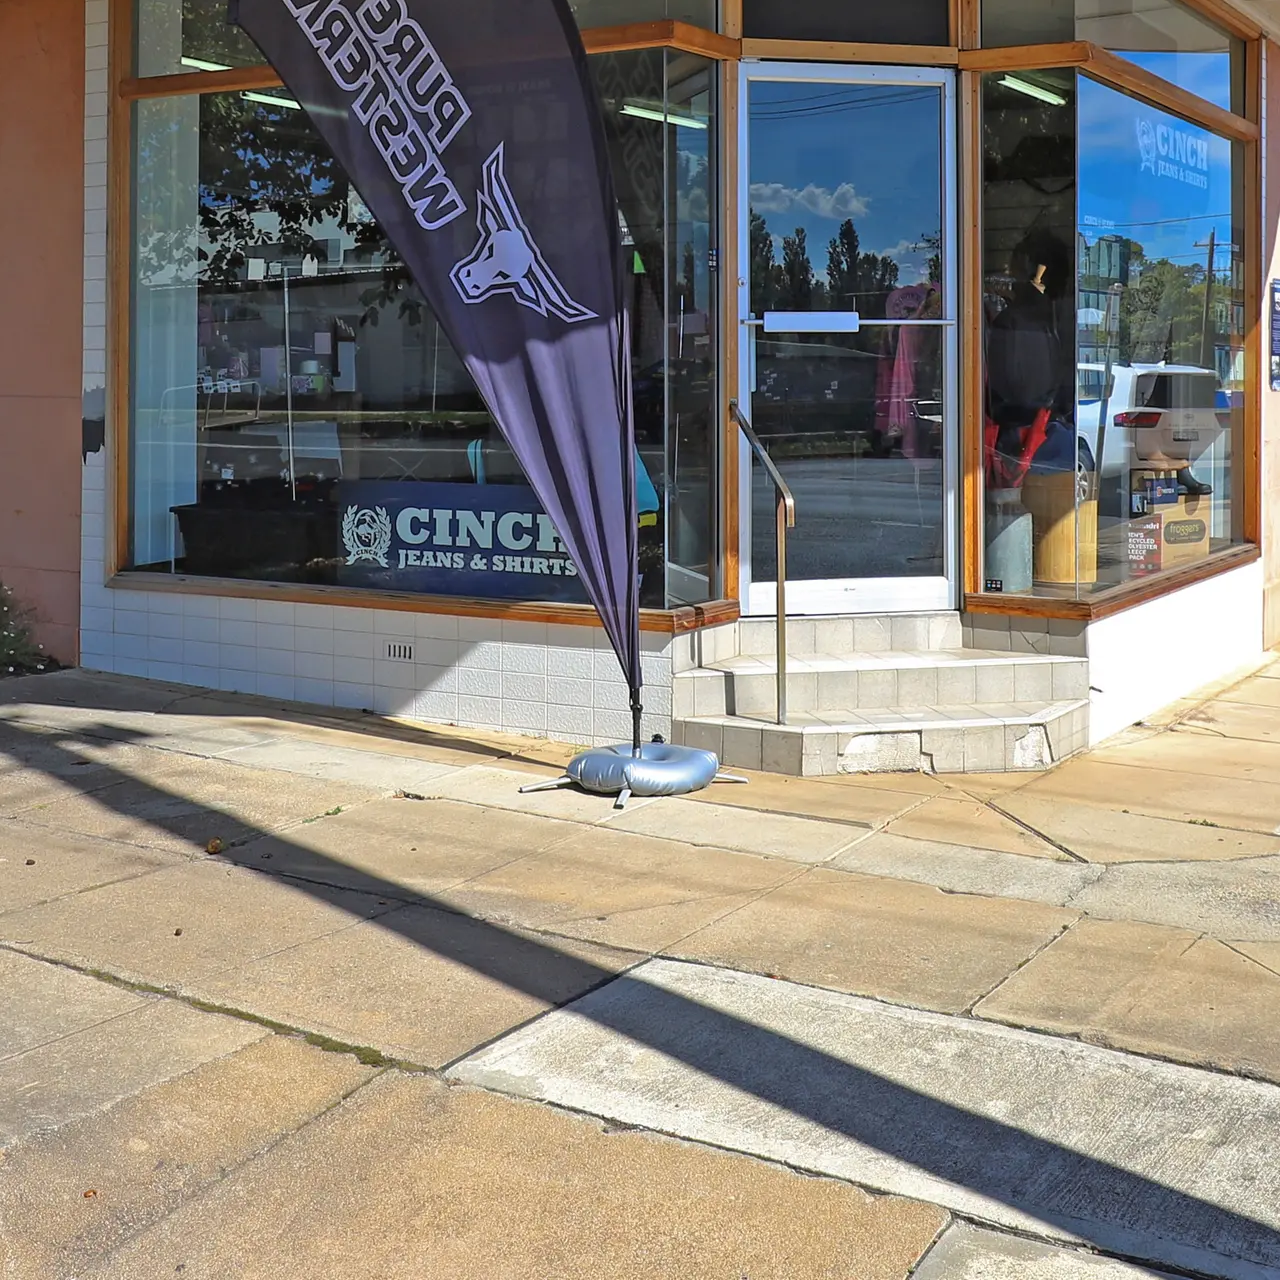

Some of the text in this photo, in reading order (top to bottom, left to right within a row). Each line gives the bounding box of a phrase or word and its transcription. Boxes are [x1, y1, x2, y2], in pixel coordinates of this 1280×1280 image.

[1156, 123, 1208, 171] CINCH
[1157, 160, 1178, 180] JEANS
[1185, 171, 1208, 190] SHIRTS
[356, 549, 378, 557] CINCH
[397, 549, 578, 577] JEANS & SHIRTS
